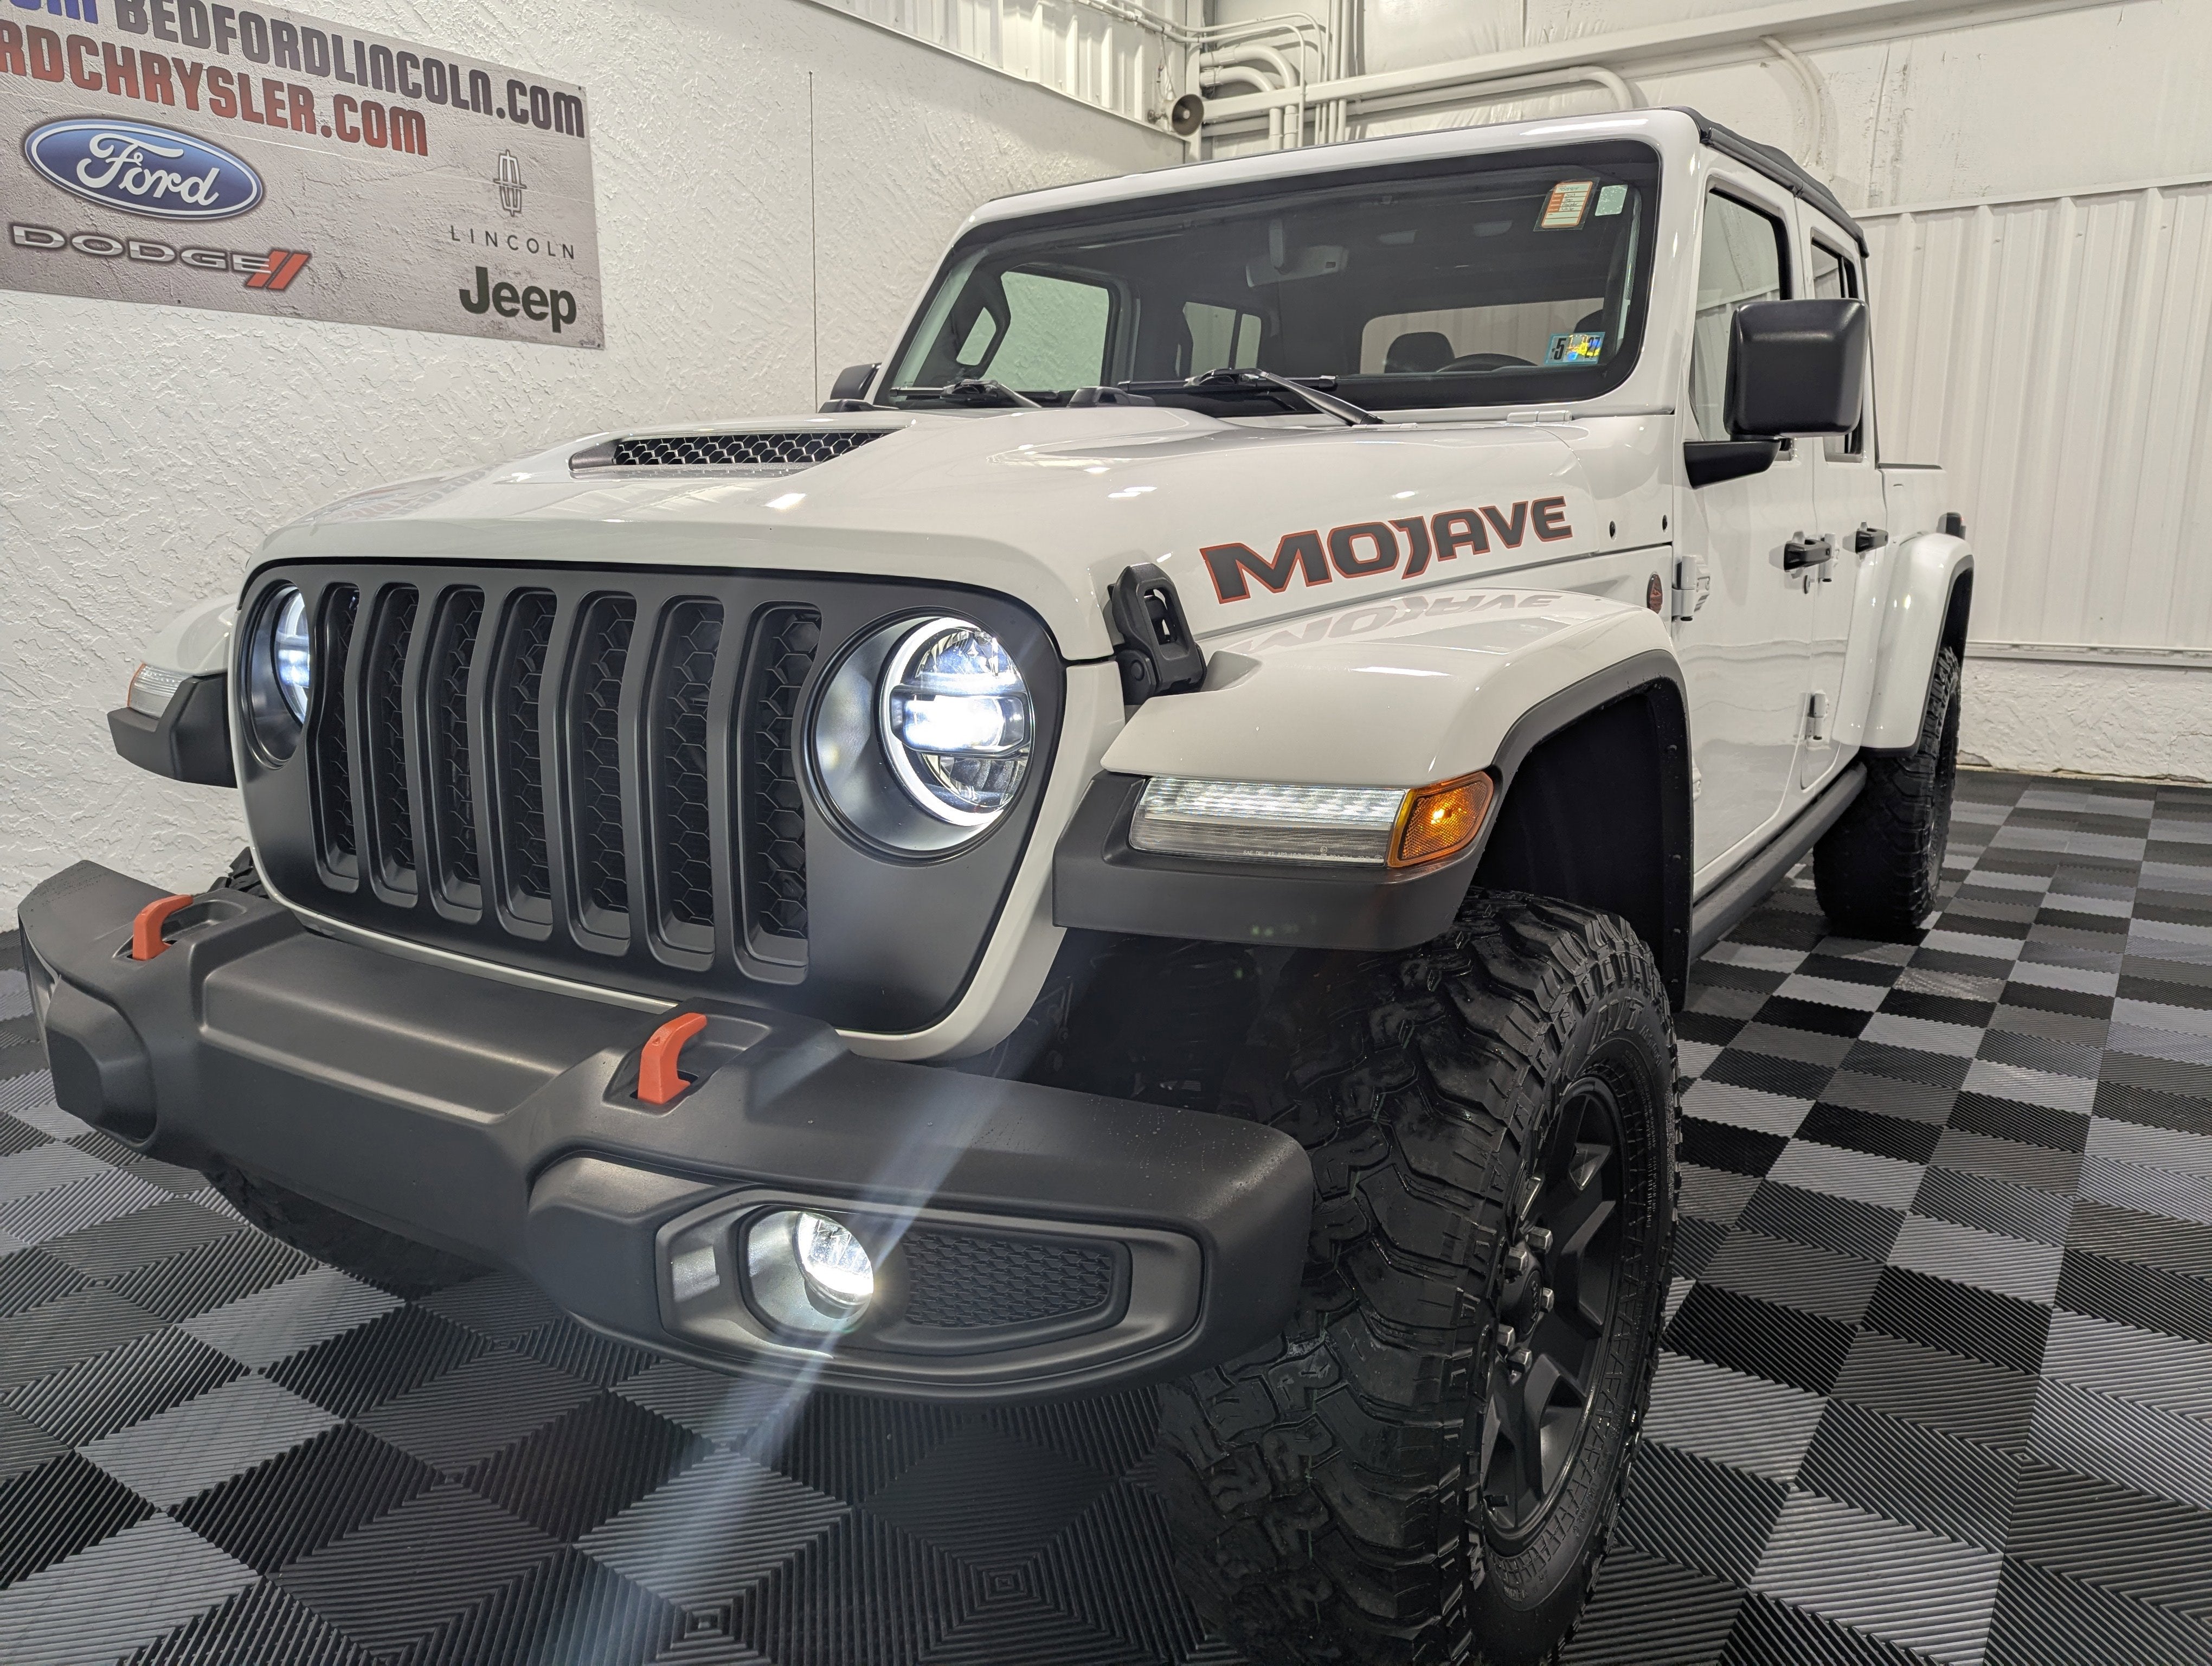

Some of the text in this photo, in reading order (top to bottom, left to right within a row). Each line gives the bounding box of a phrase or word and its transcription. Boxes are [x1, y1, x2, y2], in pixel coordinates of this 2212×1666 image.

[0, 19, 428, 157] RDCHRYSLER.COM
[115, 0, 585, 139] BEDFORDLINCOLN.COM
[76, 124, 221, 207] Ford
[12, 226, 272, 275] DODGE
[450, 225, 575, 260] LINCOLN
[459, 266, 578, 333] Jeep
[1200, 496, 1573, 604] MOJAVE
